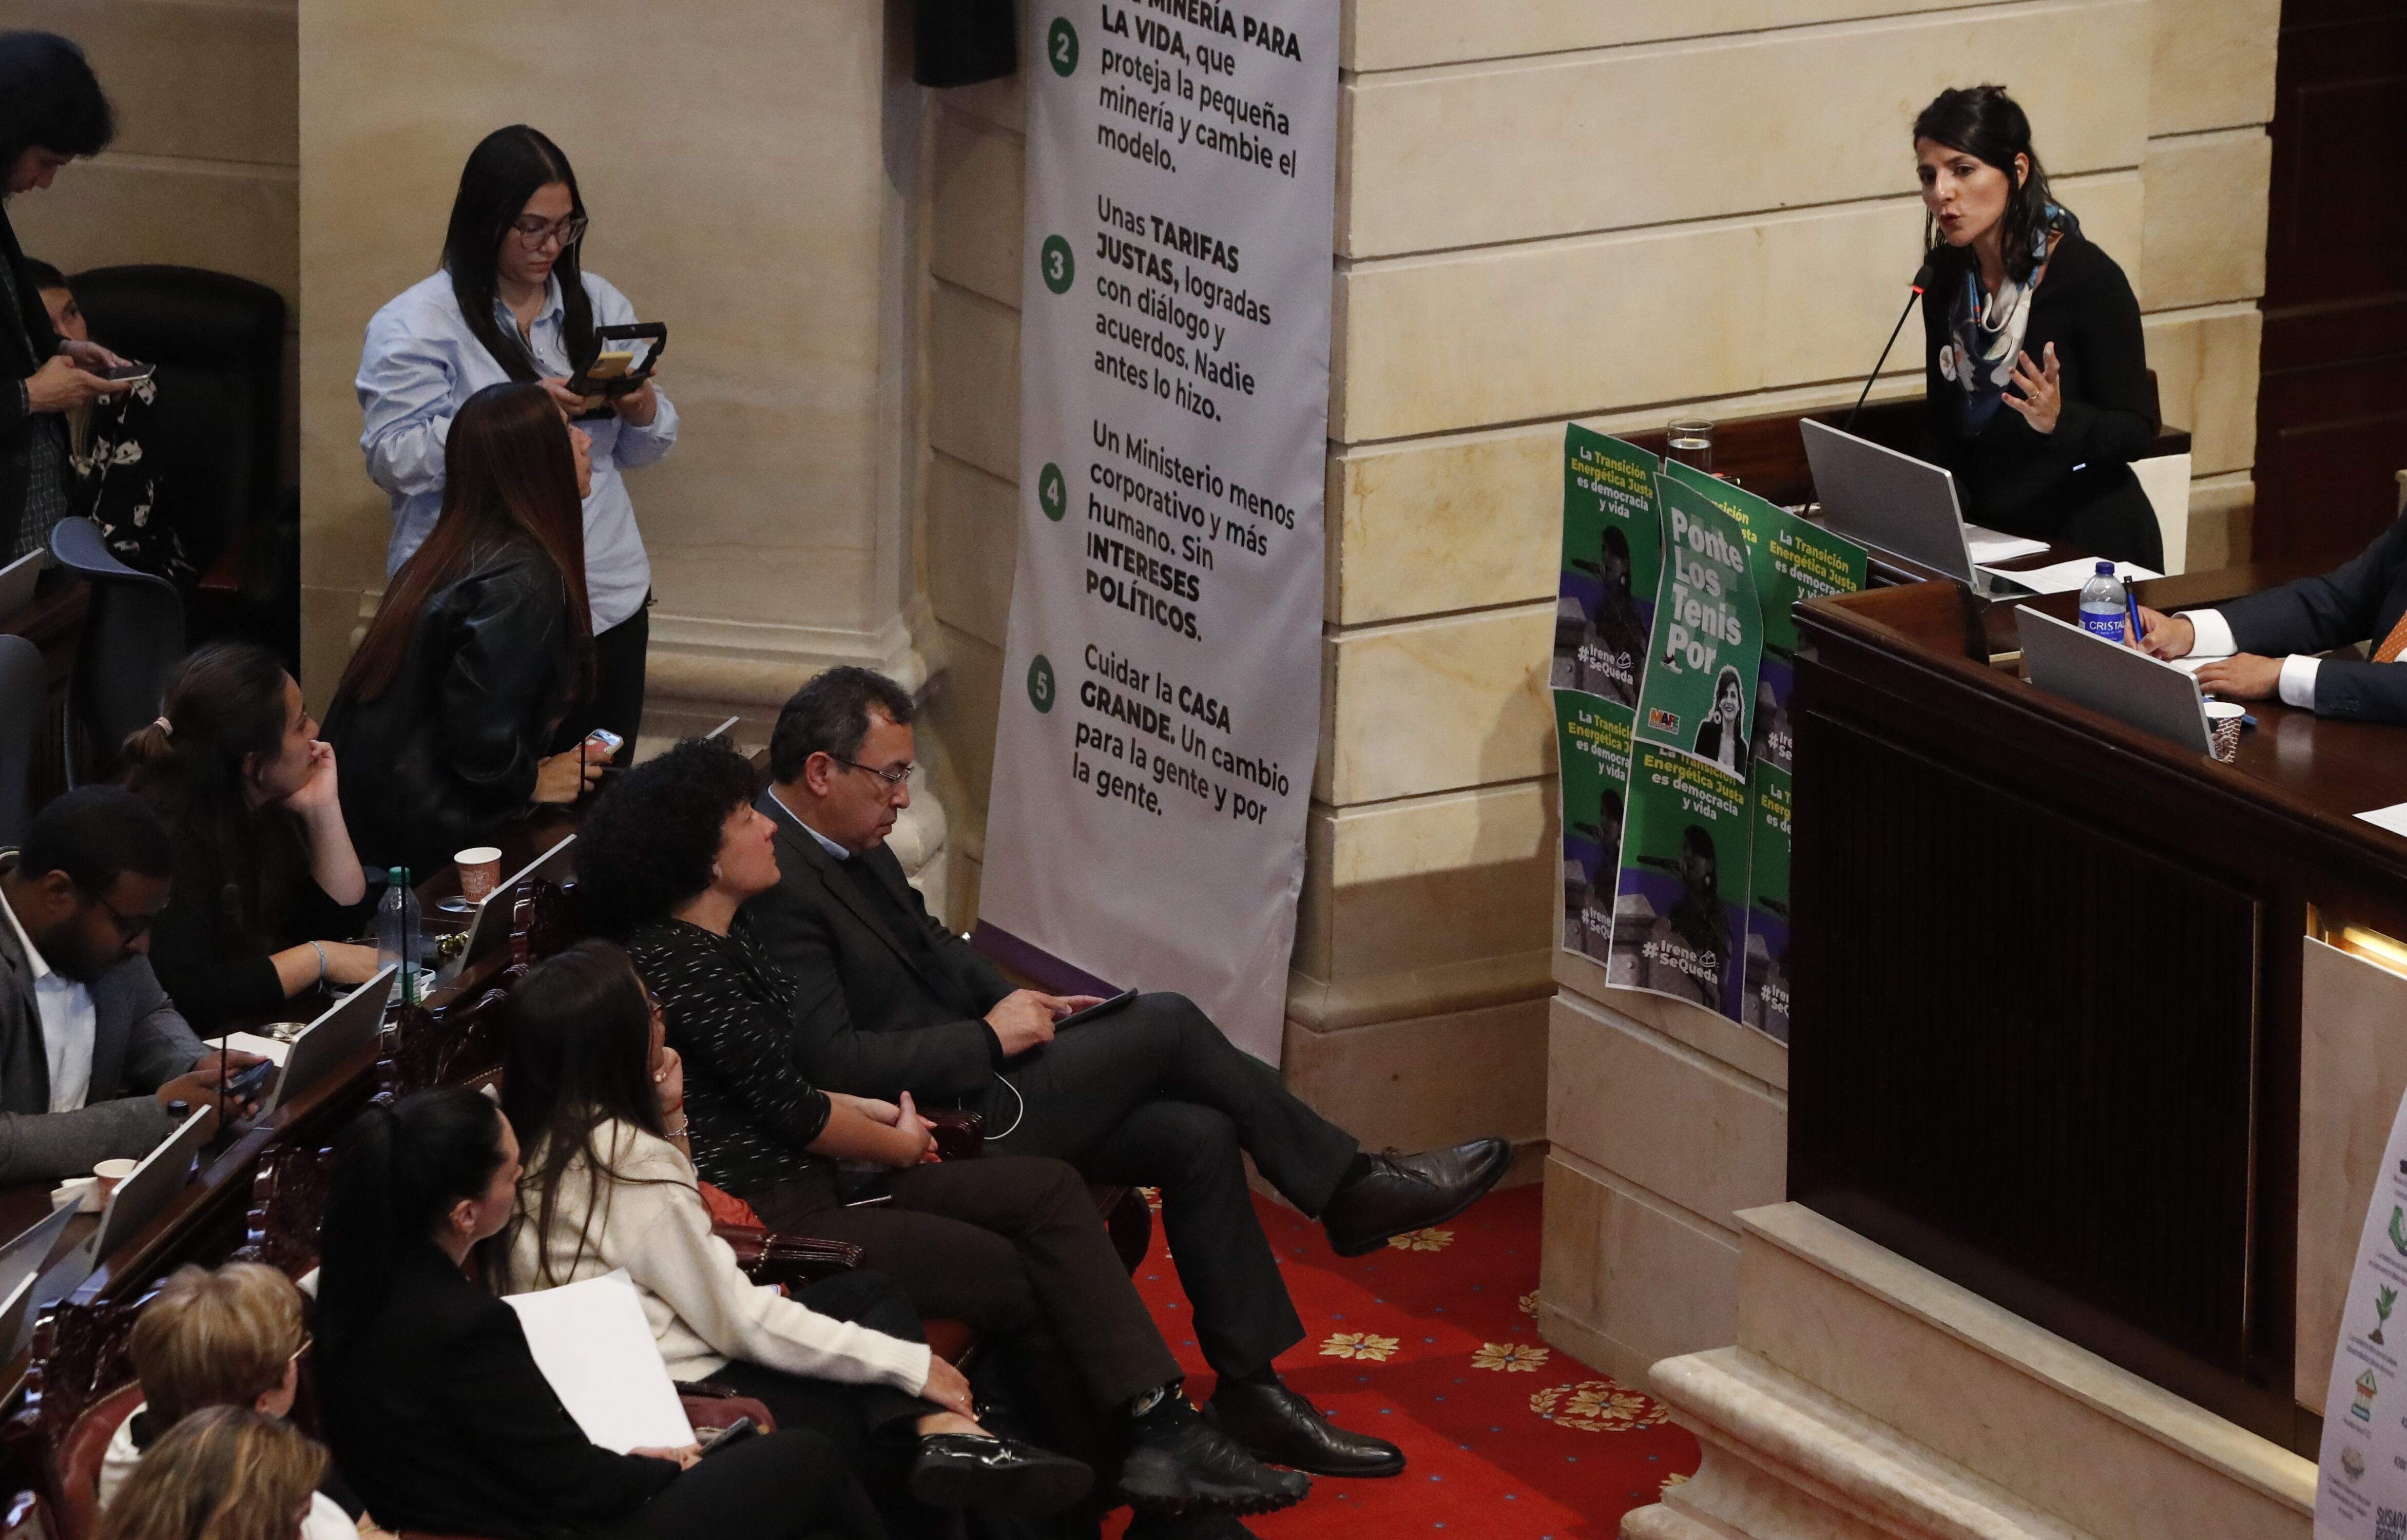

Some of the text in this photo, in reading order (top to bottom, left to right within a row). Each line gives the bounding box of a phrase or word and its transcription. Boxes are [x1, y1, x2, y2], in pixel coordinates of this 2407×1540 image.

[1057, 33, 1069, 63] 2
[1102, 4, 1235, 75] LA VIDA, que
[1243, 15, 1302, 62] PARA
[1102, 47, 1289, 135] proteja la pequeña
[1098, 124, 1176, 173] modelo.
[1100, 84, 1296, 178] minería y cambie el
[1097, 195, 1239, 273] Unas TARIFAS
[1050, 252, 1064, 280] 3
[1096, 231, 1271, 325] JUSTAS, logradas
[1097, 275, 1225, 352] con diálogo y
[1095, 312, 1255, 395] acuerdos. Nadie
[1094, 349, 1222, 422] antes lo hizo.
[1093, 418, 1295, 530] Un Ministerio menos
[1571, 457, 1653, 499] Energética Justa
[1580, 446, 1646, 480] La Transición
[1047, 477, 1060, 507] 4
[1090, 462, 1267, 556] corporativo y más
[1577, 476, 1648, 512] es democracia
[1600, 498, 1630, 518] y vida
[1088, 493, 1214, 570] humano. Sin
[1671, 506, 1744, 573] Ponte
[1741, 528, 1758, 544] sta
[1780, 529, 1848, 573] La Transición
[1086, 532, 1200, 602] INTERESES
[1674, 544, 1721, 596] Los
[1770, 540, 1857, 592] Energética Justa
[1775, 560, 1787, 573] es
[1086, 568, 1202, 642] POLÍTICOS.
[1798, 585, 1805, 599] y
[1672, 583, 1742, 646] Tenis
[2089, 620, 2125, 631] CRISTAL
[1577, 643, 1615, 665] #Irene
[1590, 657, 1633, 685] SeQueda
[1666, 623, 1717, 675] Por
[1036, 671, 1048, 700] 5
[1084, 643, 1232, 735] Cuidar la CASA
[1080, 680, 1289, 797] GRANDE. Un cambio
[1568, 721, 1622, 750] Energética
[1579, 709, 1592, 724] La
[1594, 714, 1631, 739] Transici
[1075, 721, 1267, 825] para la gente y por
[1576, 740, 1589, 752] es
[1591, 743, 1631, 768] democra
[1599, 762, 1626, 781] y vida
[1073, 753, 1162, 816] la gente.
[1644, 754, 1744, 805] Energética Justa
[1652, 773, 1739, 817] es democracia
[1770, 784, 1782, 800] La
[1682, 797, 1717, 821] y vida
[1761, 794, 1791, 821] Energ
[1766, 814, 1778, 827] es
[1590, 919, 1611, 939] SeQu
[1642, 940, 1697, 962] #Irene
[1659, 952, 1718, 985] SeQueda
